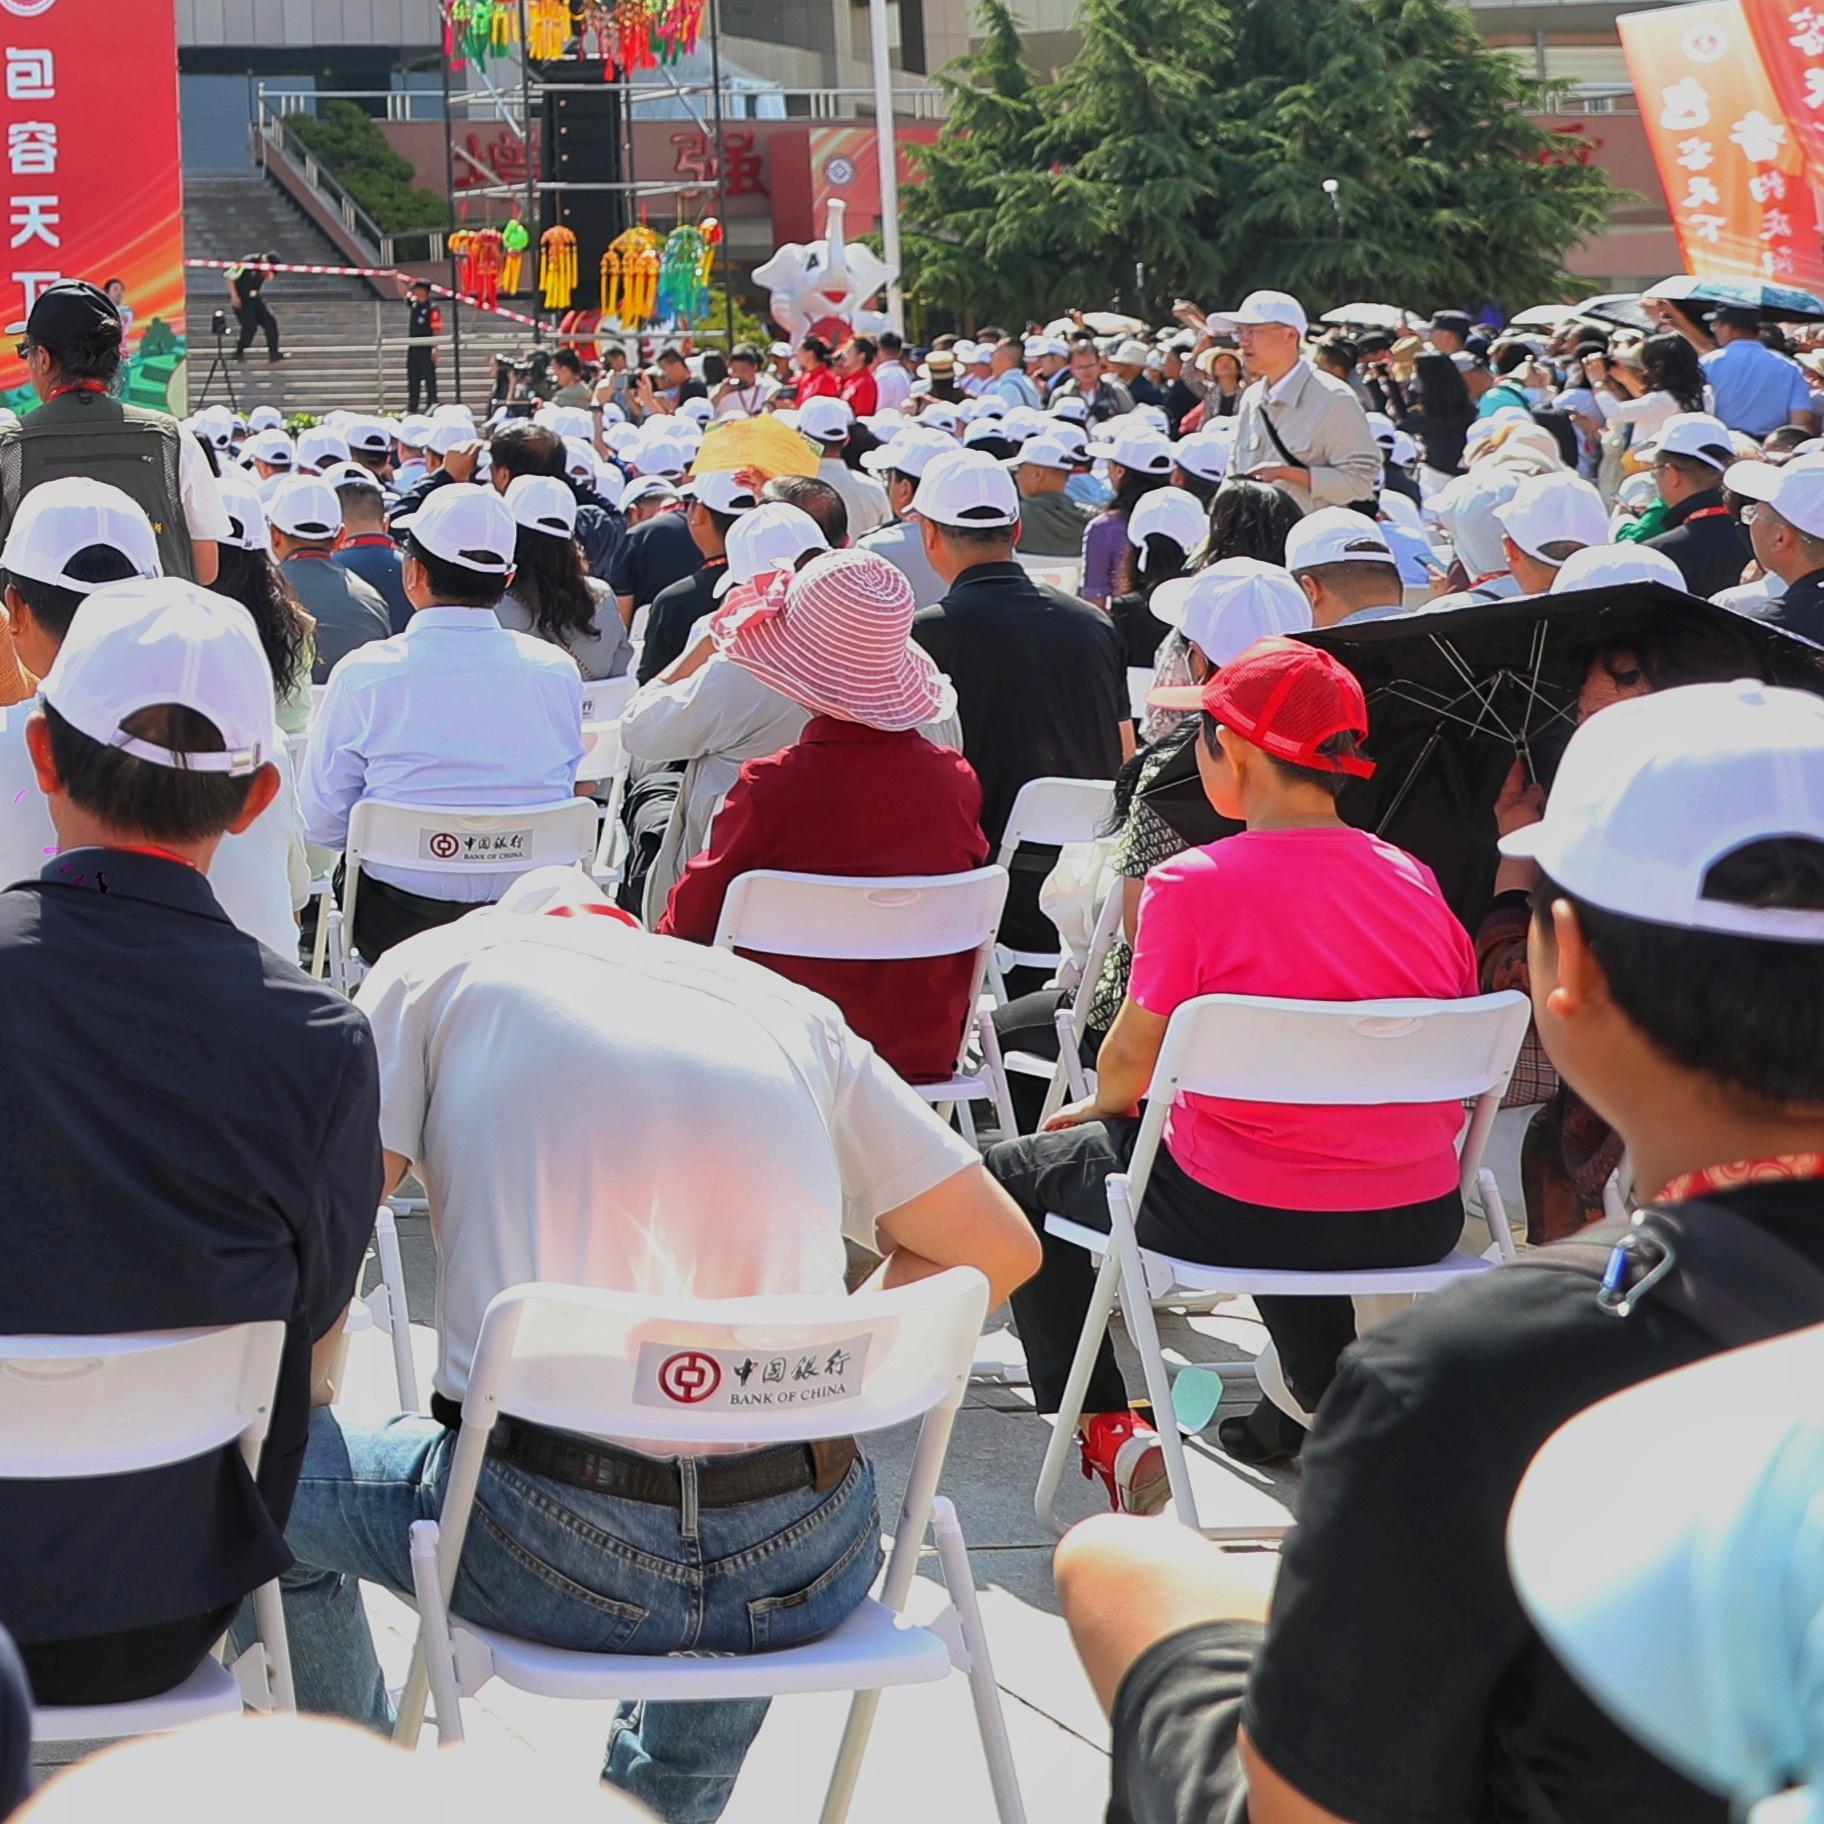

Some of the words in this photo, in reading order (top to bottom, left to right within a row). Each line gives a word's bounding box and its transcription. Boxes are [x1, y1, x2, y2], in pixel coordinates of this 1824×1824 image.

[729, 1392, 774, 1406] BANK
[776, 1391, 797, 1403] OF
[800, 1383, 847, 1401] CHINA
